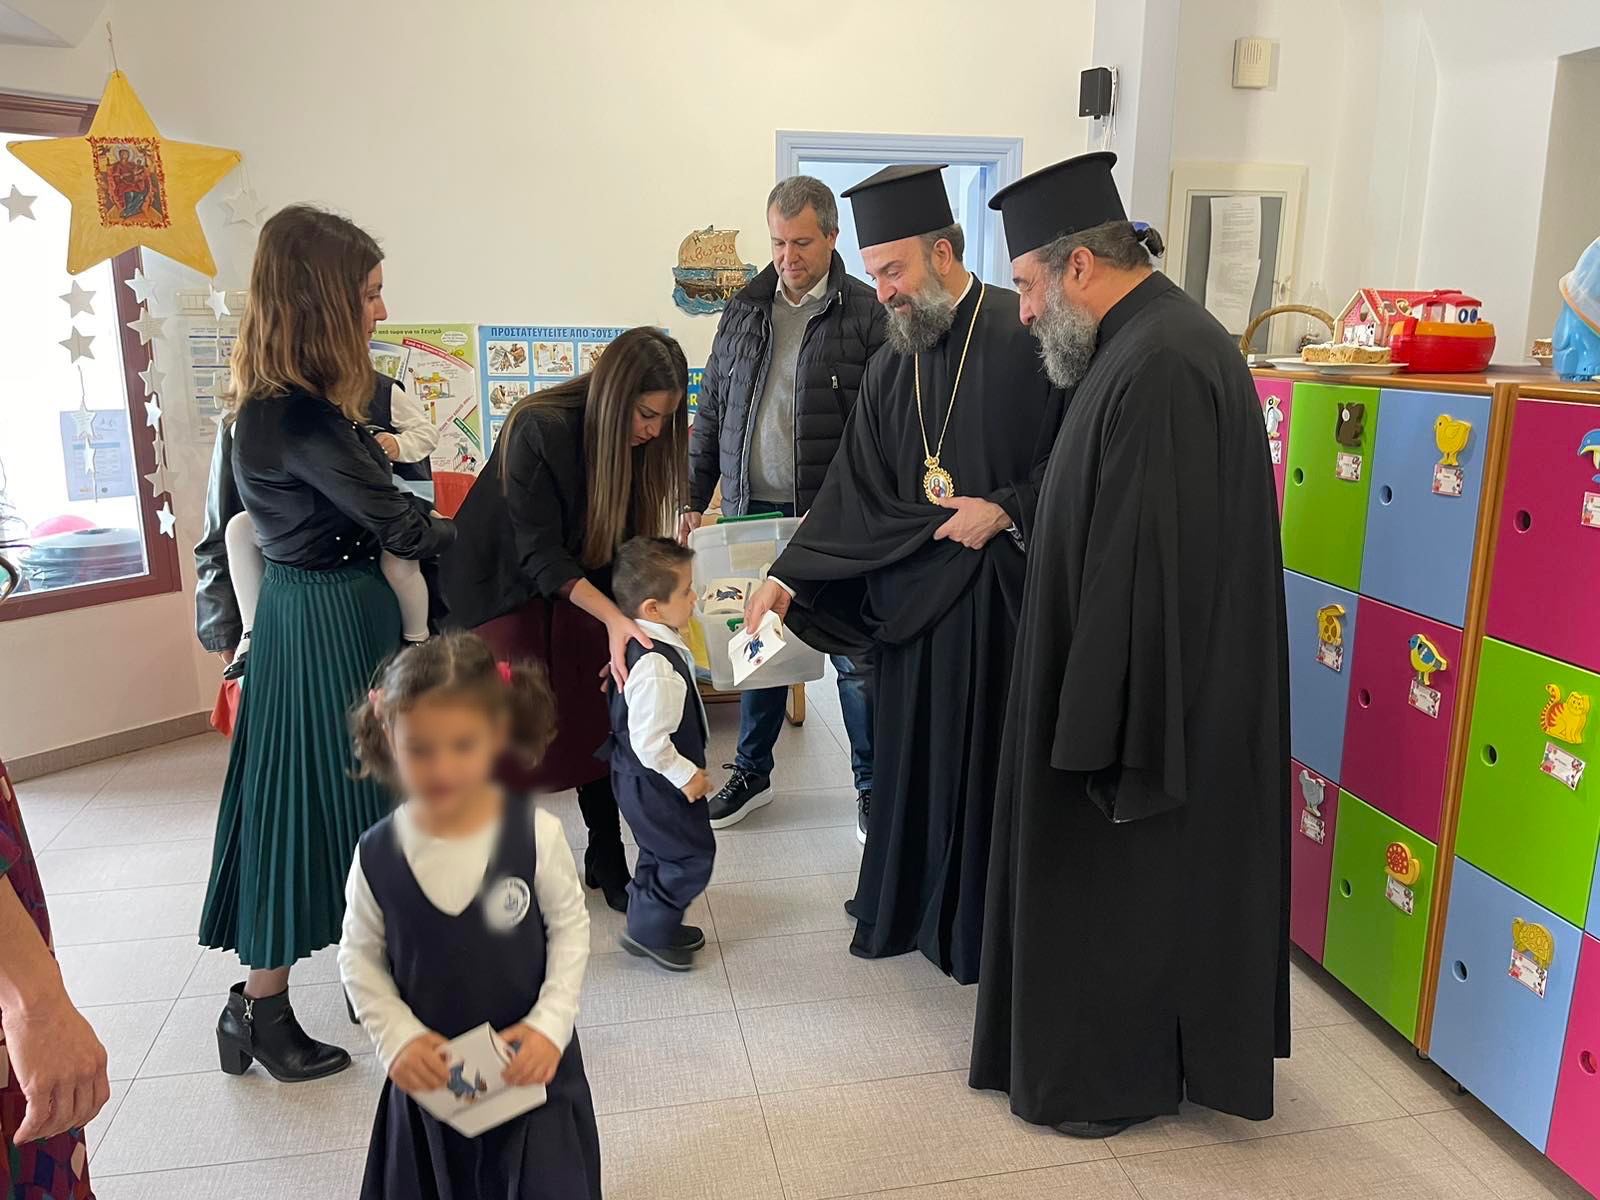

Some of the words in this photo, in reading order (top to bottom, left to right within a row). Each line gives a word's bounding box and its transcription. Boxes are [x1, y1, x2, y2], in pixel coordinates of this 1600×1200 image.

[491, 327, 568, 338] ΠΡΟΣΤΑΤΕΥΤΕΙΤΕ
[570, 328, 589, 338] ΑΠΟ
[591, 328, 613, 338] ΤΟΥΣ
